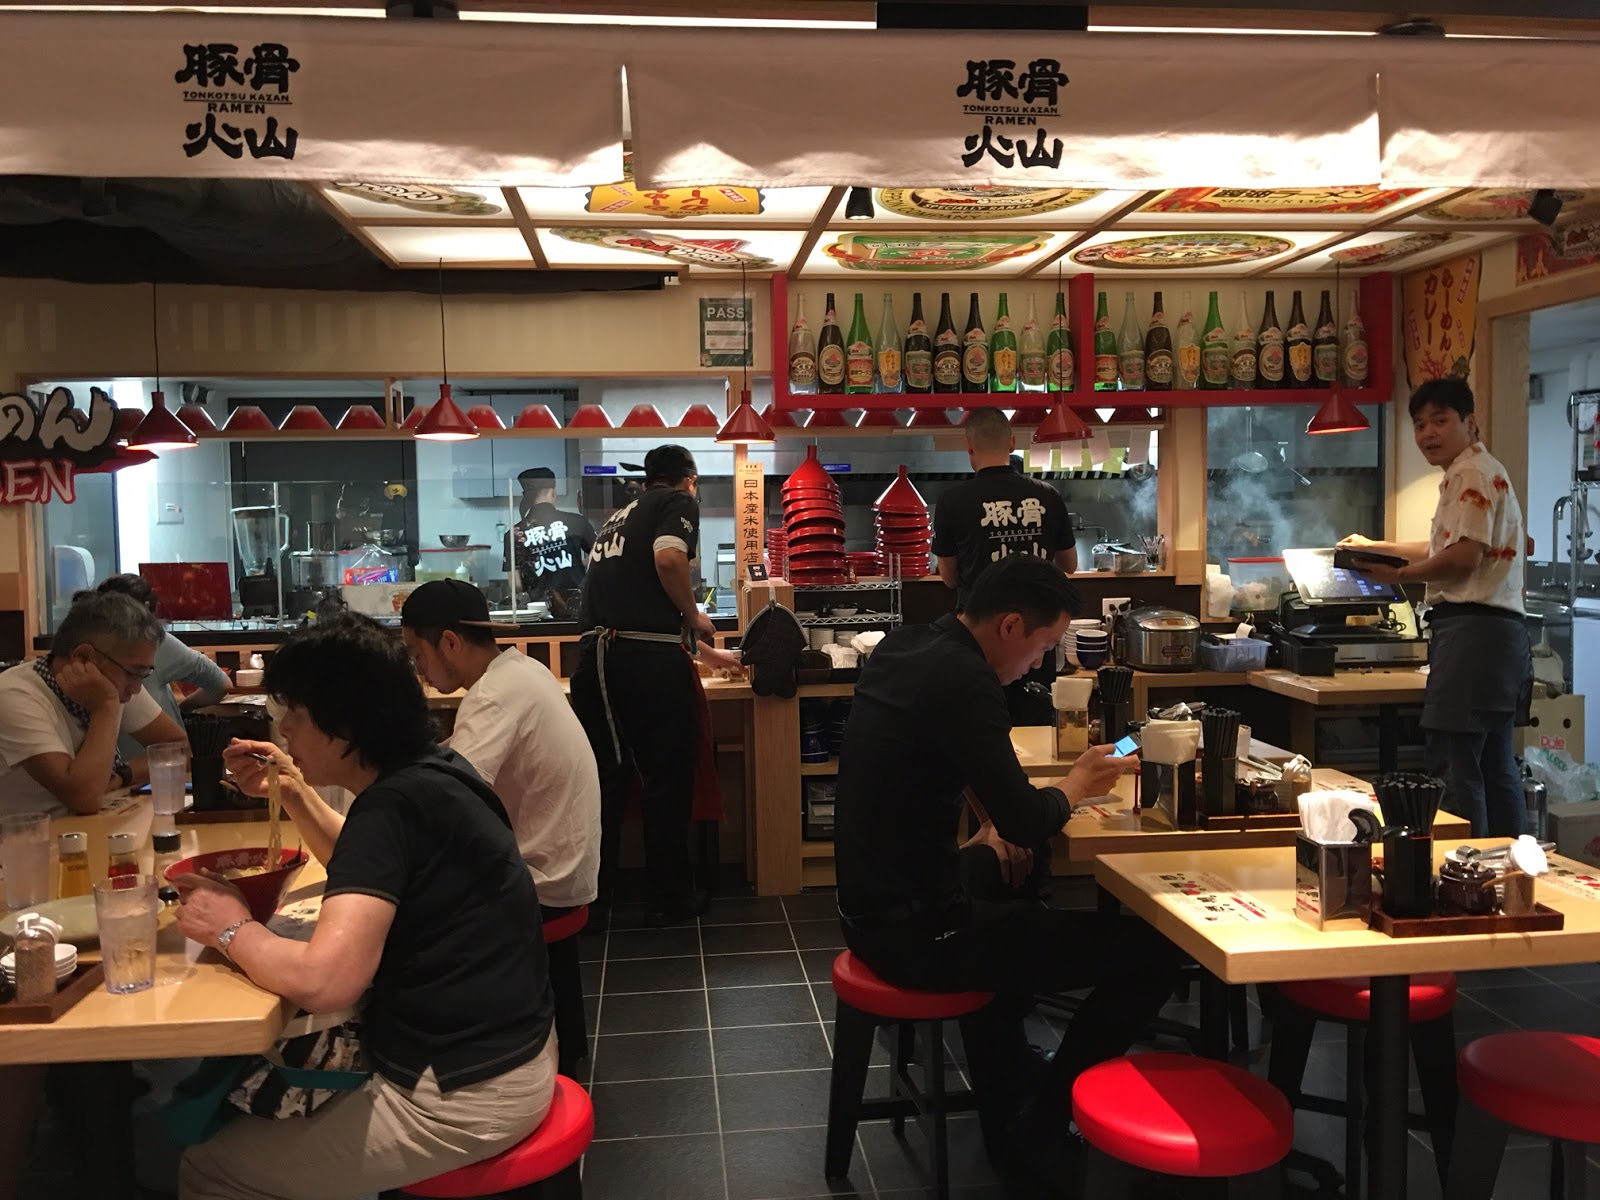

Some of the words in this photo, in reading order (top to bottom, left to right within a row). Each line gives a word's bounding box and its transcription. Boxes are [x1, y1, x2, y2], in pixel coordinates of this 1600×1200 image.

[175, 43, 300, 94] 豚骨
[183, 91, 246, 100] TONKOTSU
[957, 59, 1069, 106] 豚骨
[208, 103, 265, 113] RAMEN
[963, 104, 1019, 113] TONKOTSU
[985, 116, 1037, 125] RAMEN
[183, 113, 298, 160] 火山
[961, 125, 1064, 169] 火山
[922, 203, 986, 211] SPECIALLY
[989, 203, 1034, 211] RAMEN
[706, 307, 745, 319] PASS
[0, 461, 73, 501] EN
[743, 479, 759, 564] 日本産米使用店
[981, 498, 1046, 527] 豚骨
[524, 520, 569, 548] 豚骨
[534, 550, 572, 577] 火山
[1540, 735, 1565, 750] Dole
